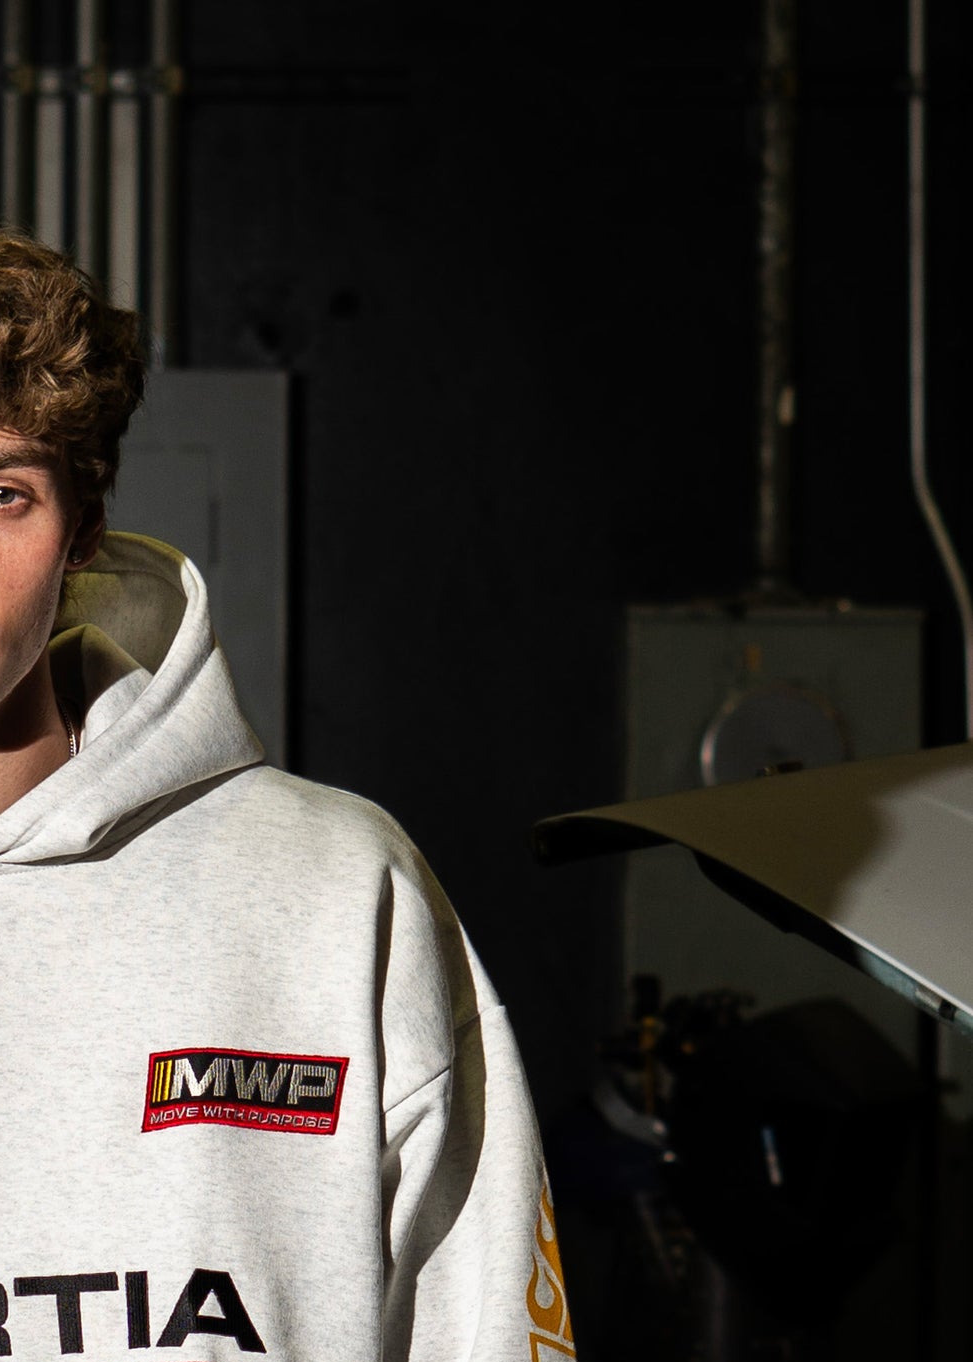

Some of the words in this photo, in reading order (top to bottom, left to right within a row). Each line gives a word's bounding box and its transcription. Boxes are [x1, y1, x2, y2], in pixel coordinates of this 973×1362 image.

[170, 1057, 337, 1105] MWP
[149, 1106, 199, 1125] MOVE
[203, 1105, 245, 1121] WITH
[248, 1110, 332, 1129] PURPOSE
